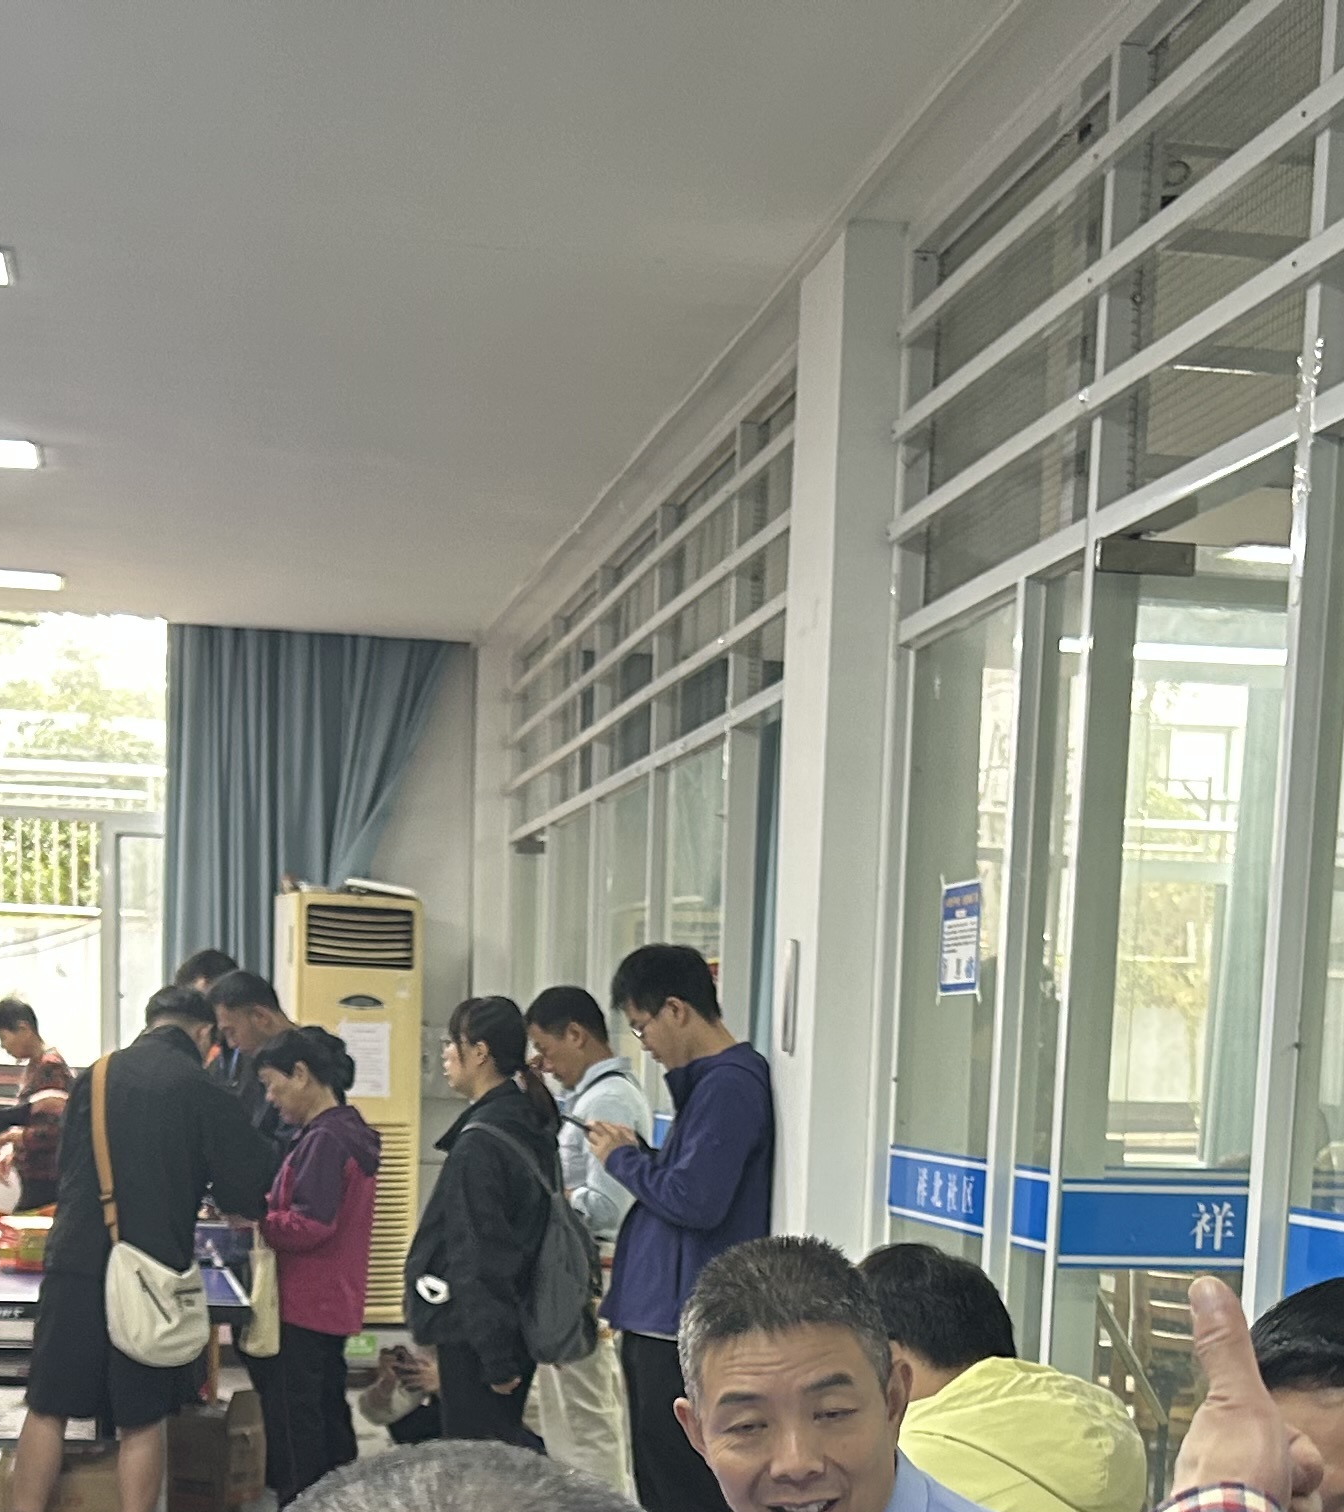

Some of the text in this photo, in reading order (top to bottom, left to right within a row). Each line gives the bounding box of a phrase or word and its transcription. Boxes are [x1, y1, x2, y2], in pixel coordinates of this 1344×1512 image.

[916, 1166, 975, 1214] 祥北社区
[1189, 1201, 1235, 1251] 祥
